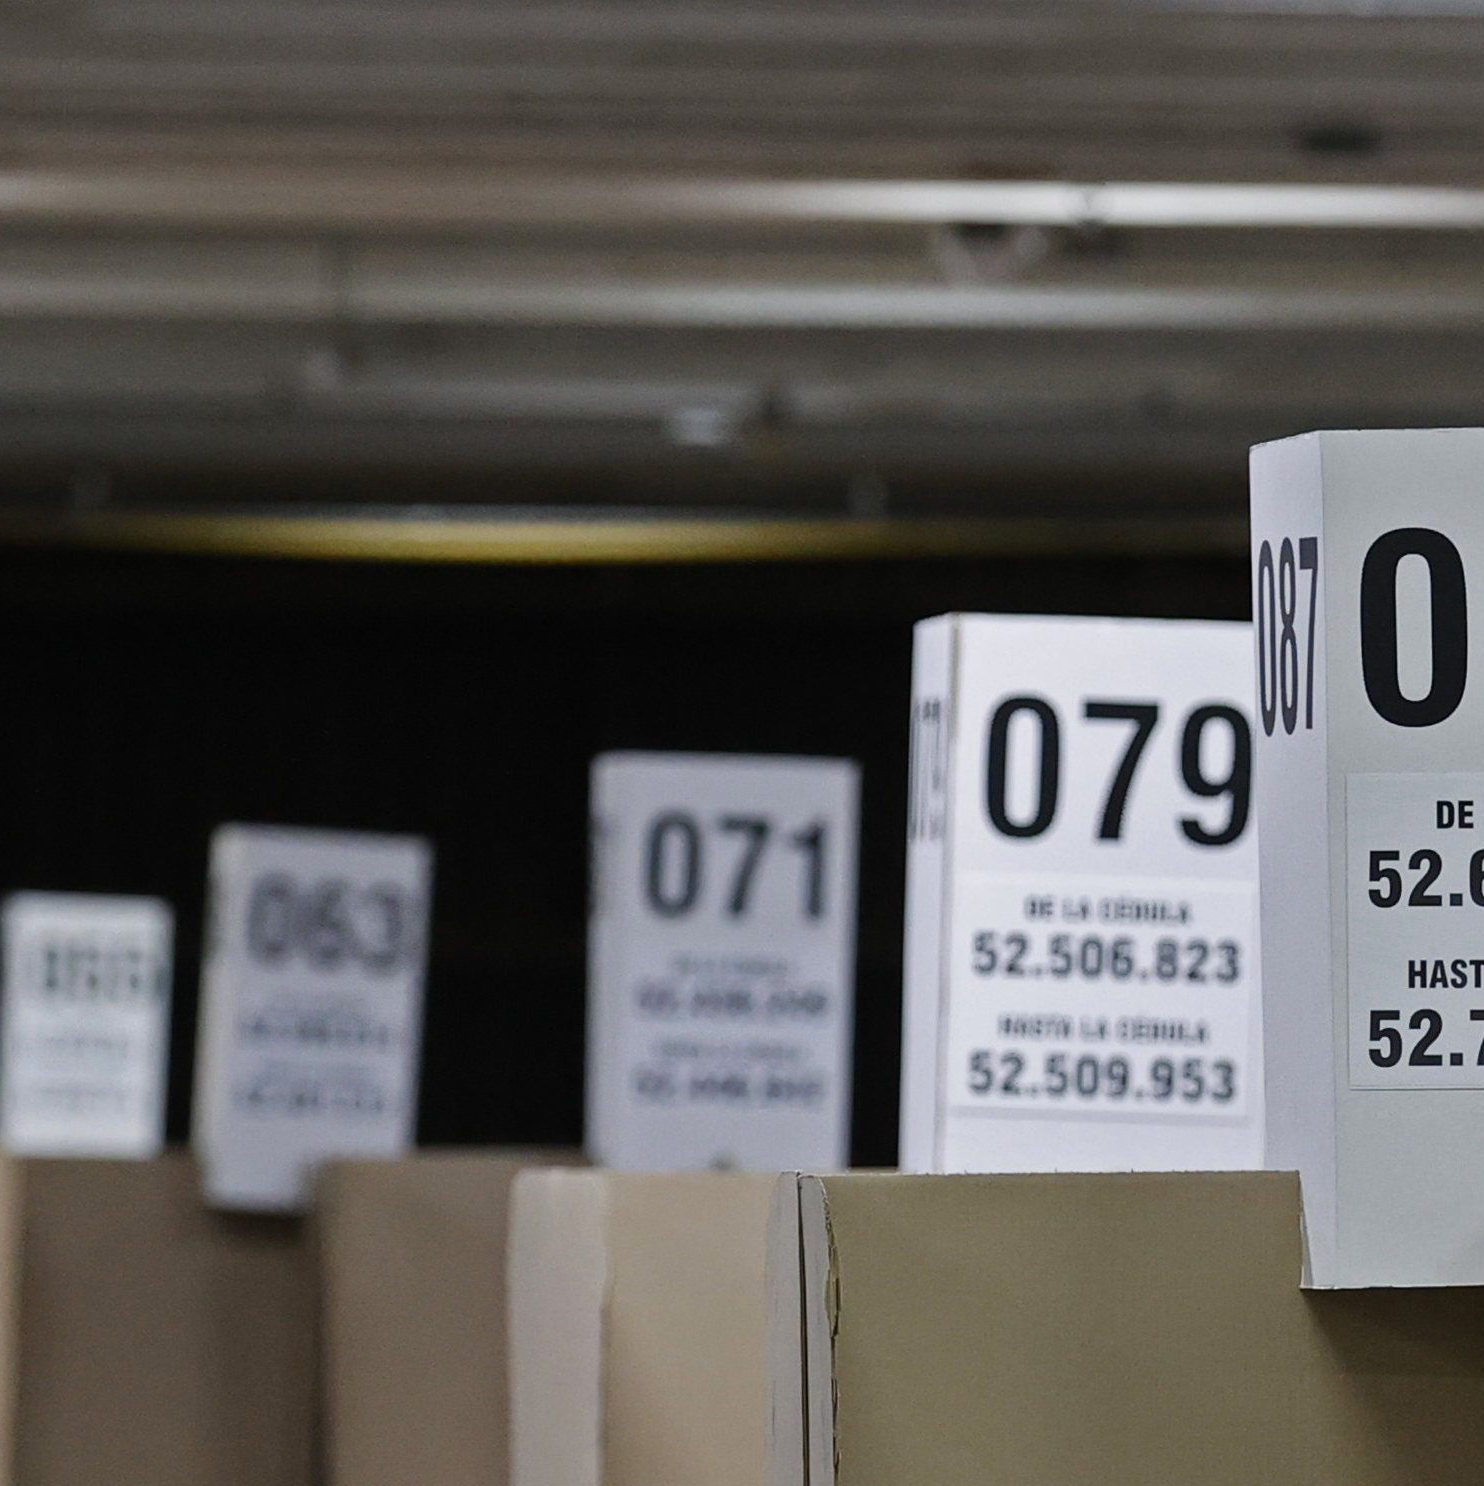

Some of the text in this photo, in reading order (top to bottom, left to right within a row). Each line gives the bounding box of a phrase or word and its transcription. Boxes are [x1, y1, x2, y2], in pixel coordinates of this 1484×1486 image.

[1259, 537, 1318, 738] 087
[984, 695, 1253, 848] 079
[1436, 800, 1474, 829] DE
[643, 810, 829, 922] 071
[973, 930, 1241, 984] 52.506.823
[969, 1050, 1237, 1105] 52.509.953
